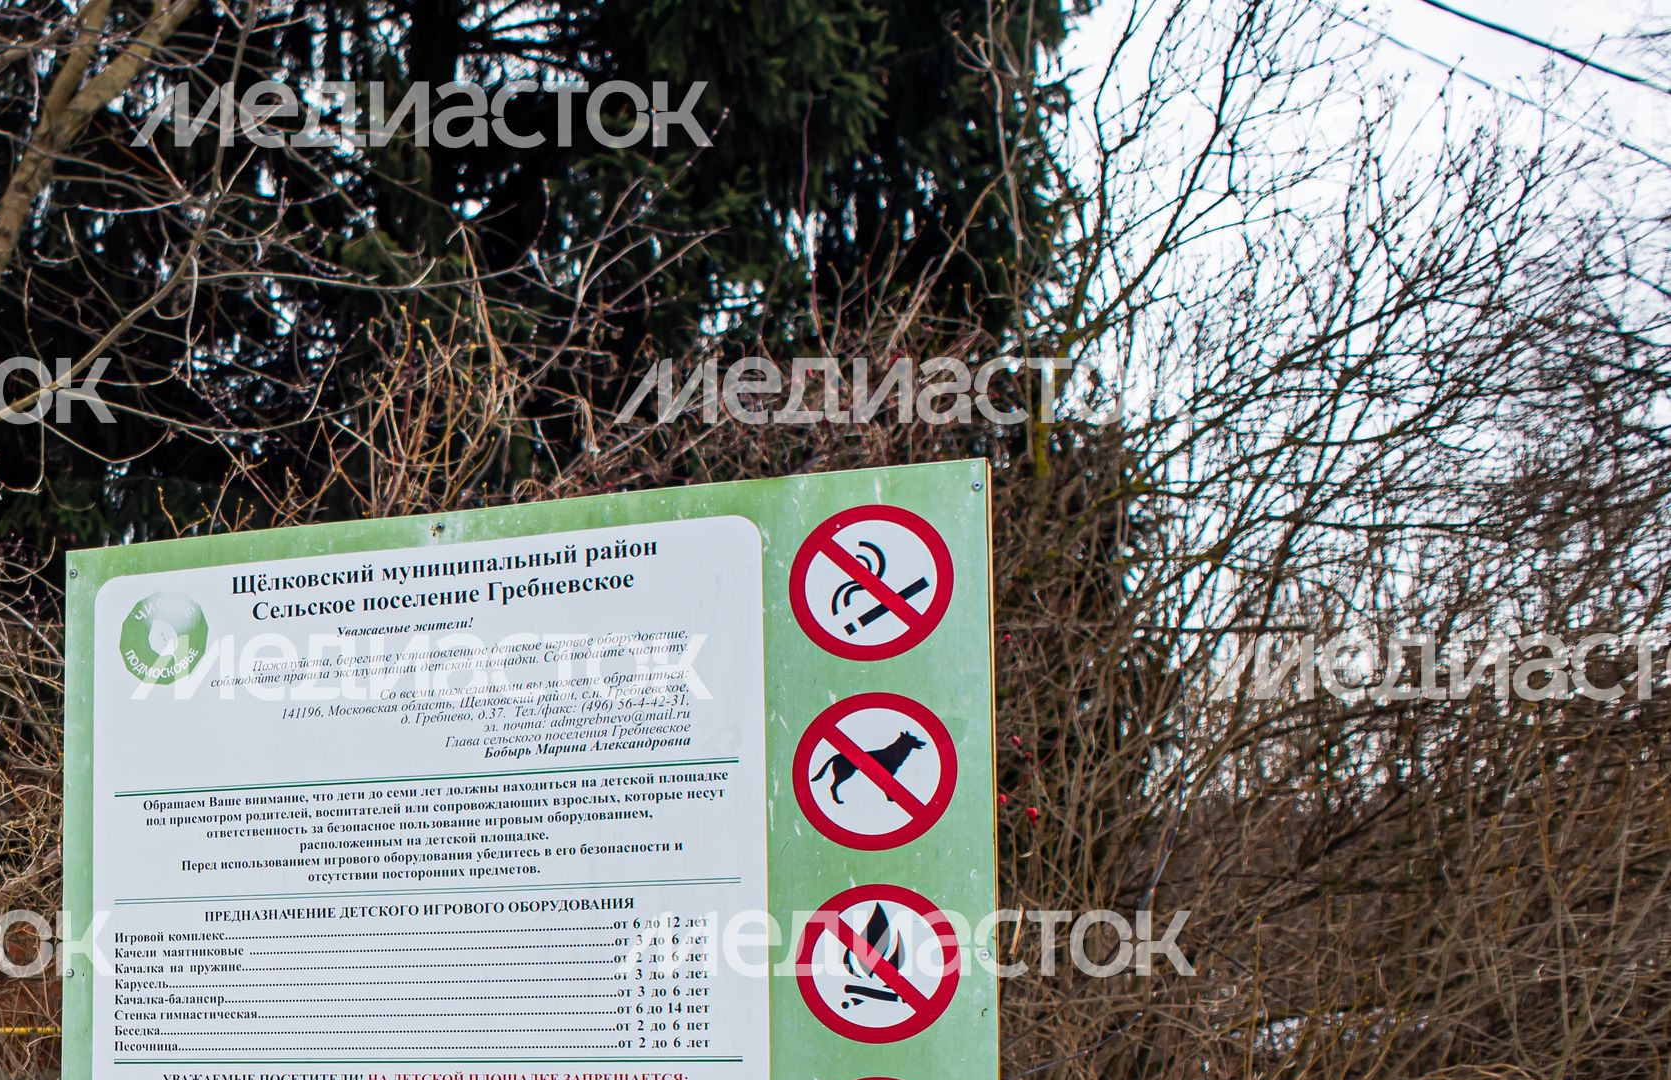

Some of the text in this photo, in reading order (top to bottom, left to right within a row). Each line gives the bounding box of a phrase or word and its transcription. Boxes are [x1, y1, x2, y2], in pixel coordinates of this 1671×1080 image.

[231, 538, 658, 597] Щёлковский муниципальный район
[251, 572, 635, 621] Сельское поселение Гребневское
[335, 615, 475, 639] Уважаемые жители!
[125, 647, 199, 679] ПОДМОСКОВЬЕ
[483, 735, 692, 759] Бобырь Марина Александровна
[142, 798, 206, 812] Обращаем
[208, 795, 242, 808] Ваше
[311, 791, 334, 802] что
[335, 790, 365, 802] дети
[385, 787, 418, 799] семи
[419, 786, 443, 797] лет
[444, 783, 500, 797] должны
[502, 778, 578, 793] находиться
[599, 771, 655, 788] детской
[657, 770, 729, 784] площадке
[145, 816, 167, 827] под
[168, 812, 242, 828] присмотром
[314, 802, 402, 818] воспитателей
[404, 803, 430, 814] или
[432, 796, 550, 815] сопровождающих
[623, 790, 684, 805] которые
[686, 787, 726, 802] несут
[205, 825, 309, 839] ответственность
[325, 820, 396, 834] безопасное
[398, 817, 482, 831] пользование
[483, 814, 544, 829] игровым
[298, 837, 403, 854] расположенным
[423, 831, 477, 847] детской
[180, 841, 671, 874] Перед использованием игрового оборудования убедитесь его безопасности
[306, 870, 379, 883] отсутствии
[381, 867, 466, 882] посторонних
[204, 896, 635, 924] ПРЕДНАЗНАЧЕНИЕ ДЕТСКОГО ИГРОВОГО ОБОРУДОВАНИЯ
[113, 946, 245, 959] Качели маятниковые
